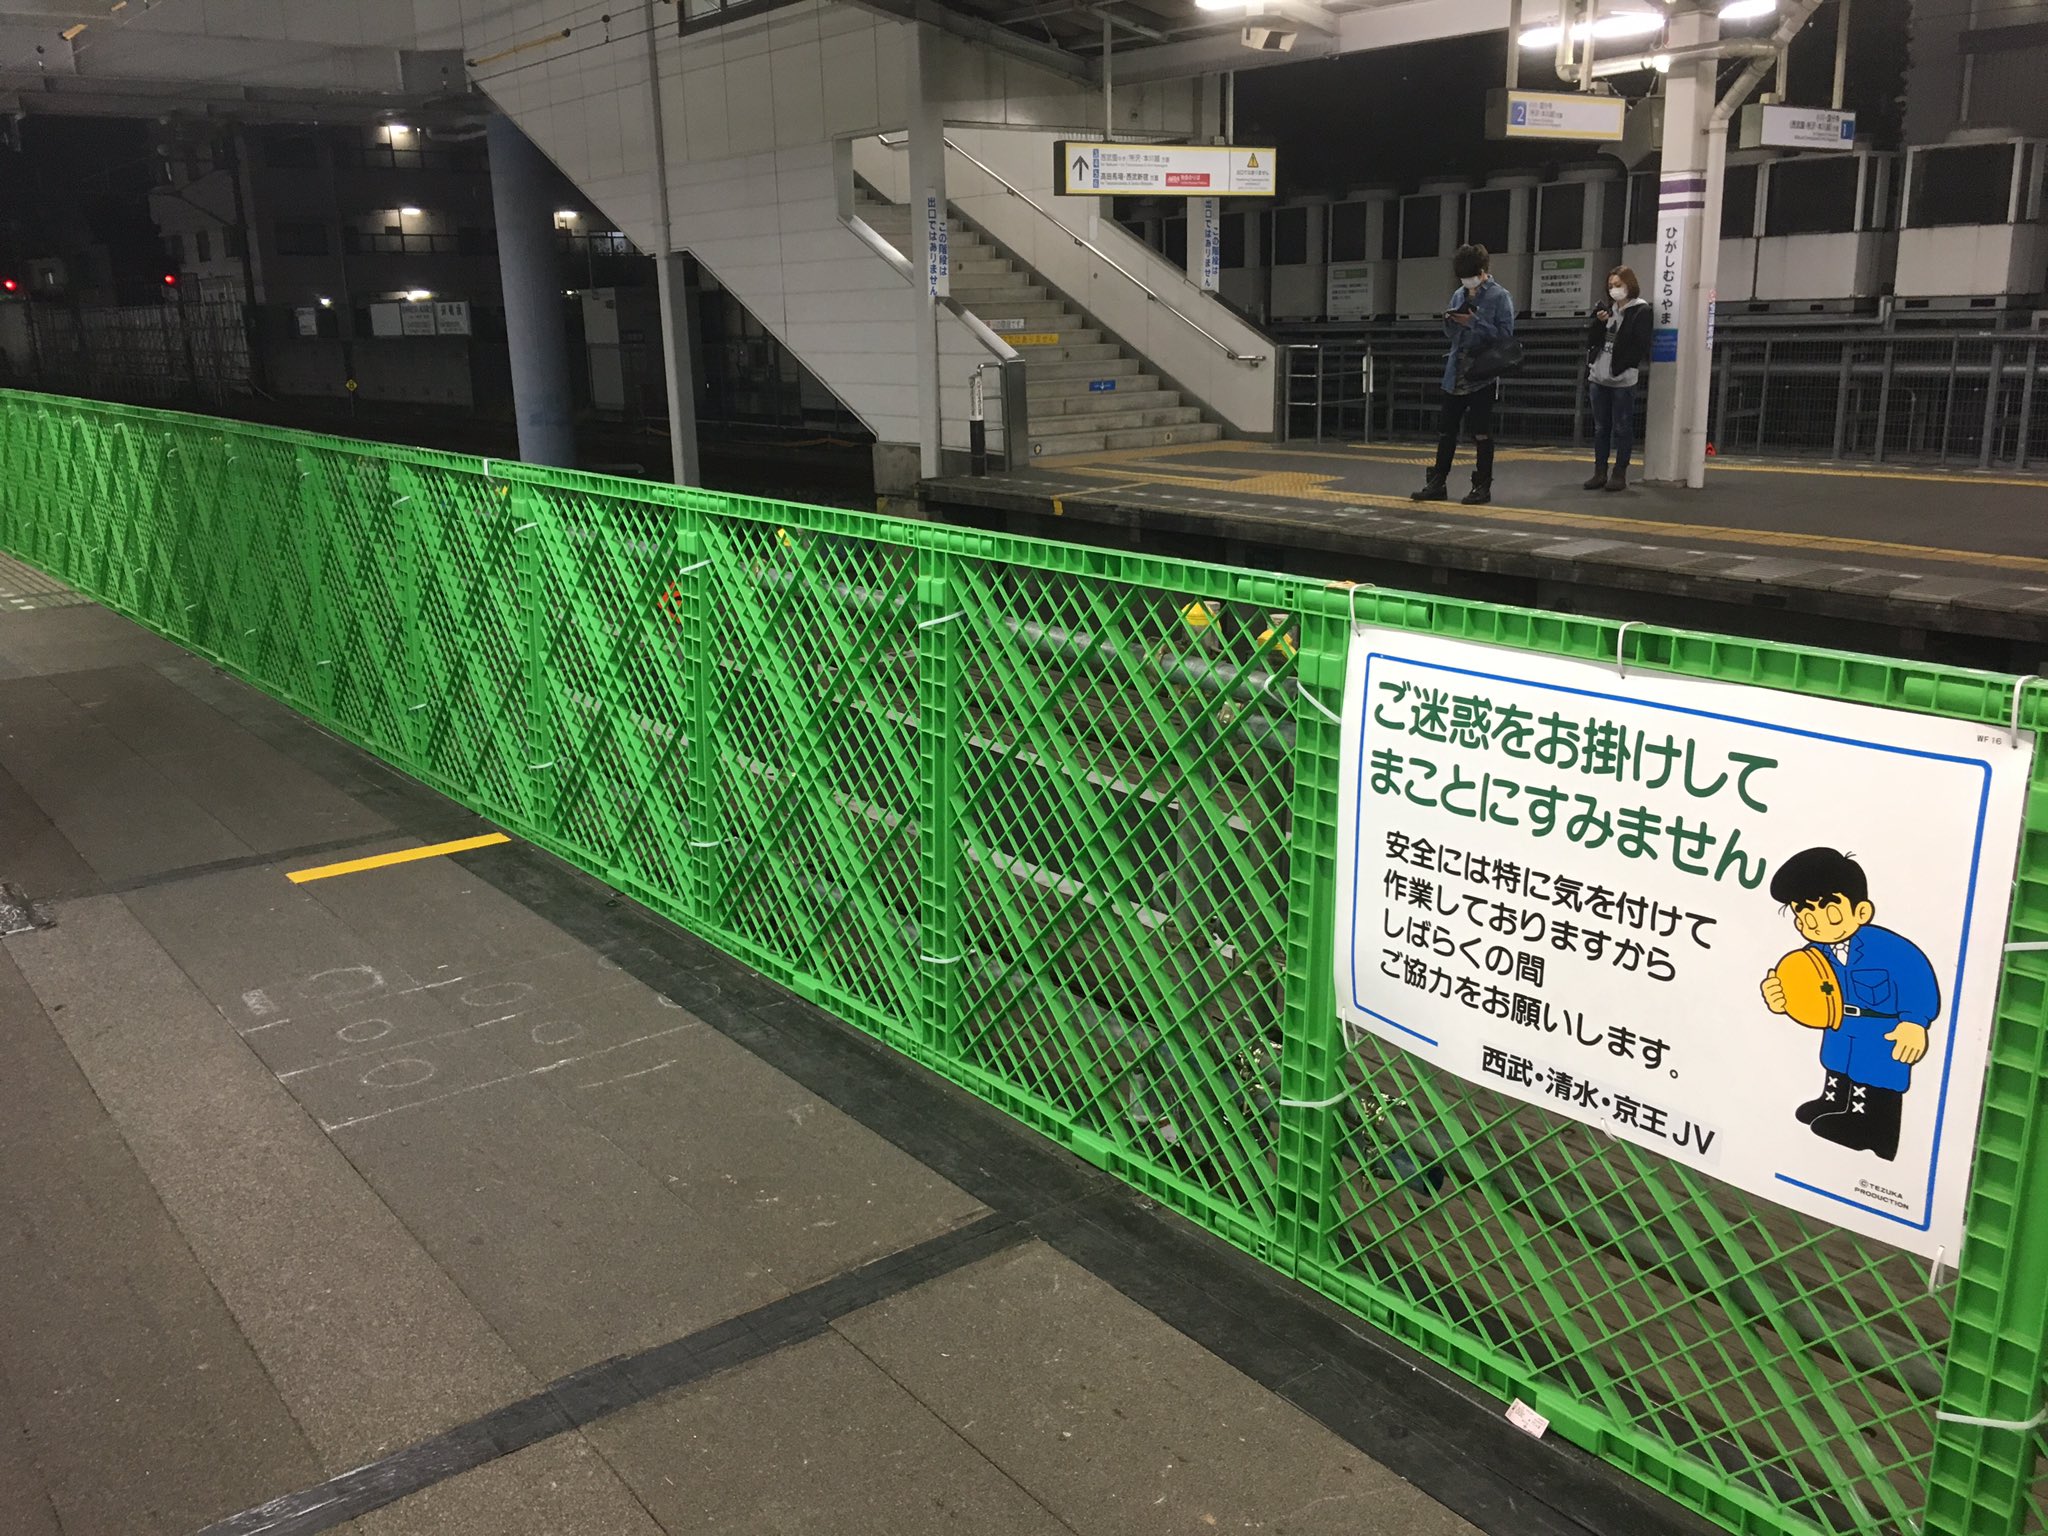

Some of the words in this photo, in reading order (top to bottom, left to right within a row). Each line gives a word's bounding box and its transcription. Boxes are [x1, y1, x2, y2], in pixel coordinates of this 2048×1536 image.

[928, 197, 938, 296] 出口ではありません
[938, 222, 948, 276] この階段は
[1204, 200, 1212, 287] 出口ではありません
[1661, 226, 1677, 325] ひがしむらやま
[1374, 681, 1779, 814] ご迷惑をお掛けして
[1977, 735, 1990, 743] WF
[1370, 748, 1767, 890] まことにすみません
[1383, 868, 1676, 982] 作業しておりますから
[1385, 830, 1718, 950] 安全には特に気を付けて
[1384, 908, 1546, 988] しばらくの間
[1380, 948, 1679, 1080] ご協力をお願いします。
[1854, 1187, 1909, 1210] PRODUCTION
